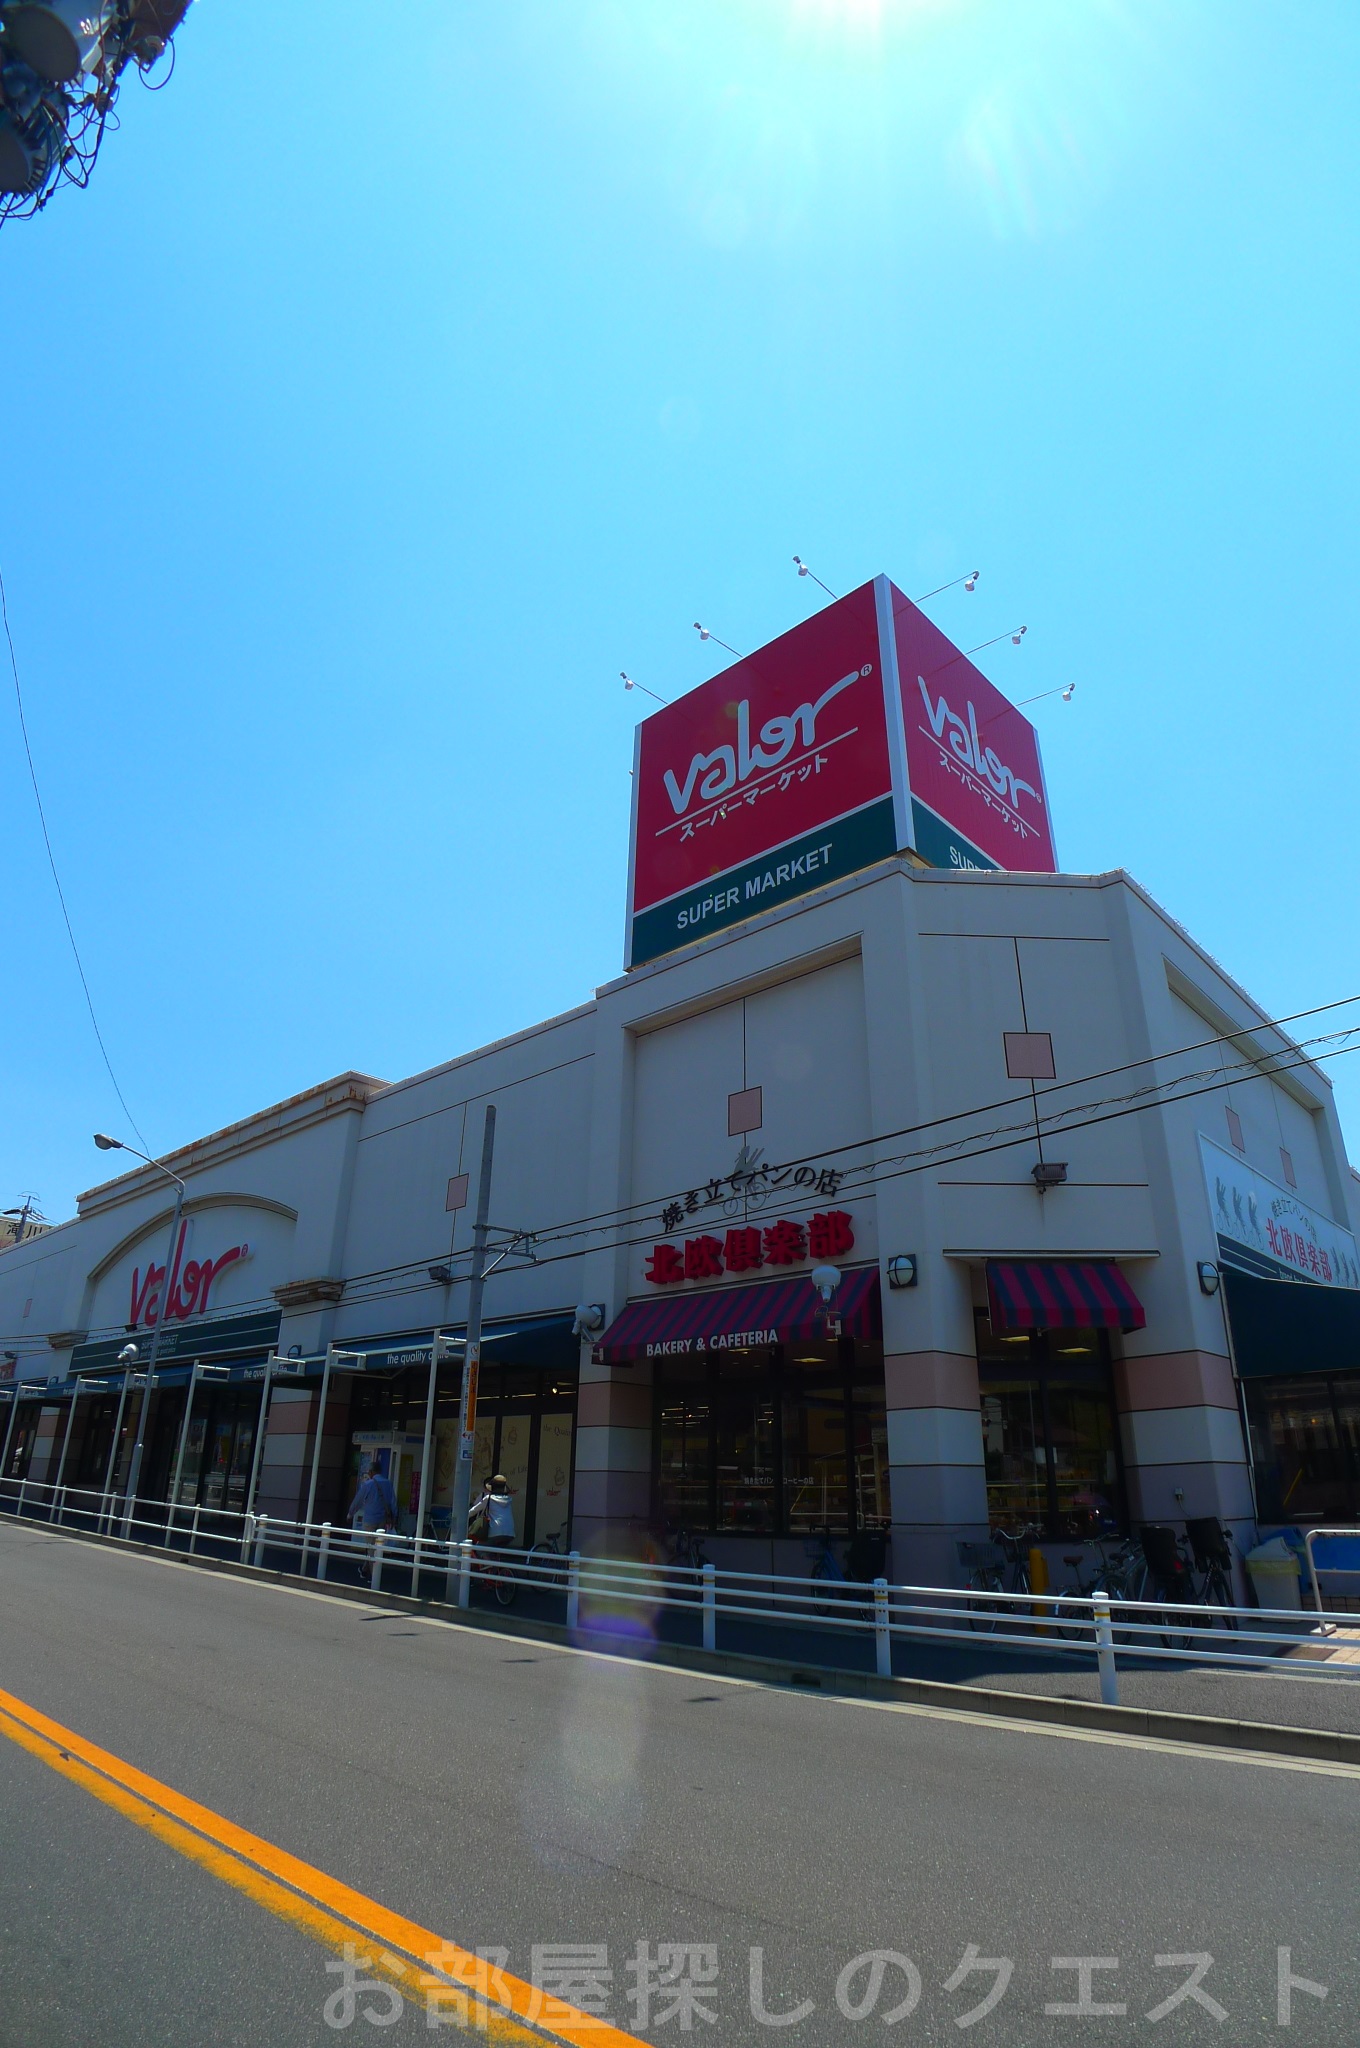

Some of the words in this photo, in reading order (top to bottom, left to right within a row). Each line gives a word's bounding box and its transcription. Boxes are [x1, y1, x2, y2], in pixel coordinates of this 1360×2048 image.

[678, 754, 829, 842] スーパーマーケット
[938, 750, 1029, 839] スーパーマーケット
[676, 885, 740, 930] SUPER
[744, 843, 833, 901] MARKET
[661, 1163, 843, 1232] 焼き立てパンの店
[645, 1210, 855, 1285] 北欧倶楽部
[1265, 1218, 1333, 1282] 北欧倶楽部
[387, 1353, 399, 1365] the
[400, 1350, 426, 1365] quality
[646, 1339, 692, 1357] BAKERY
[696, 1338, 706, 1352] &
[709, 1328, 779, 1349] CAFETERIA
